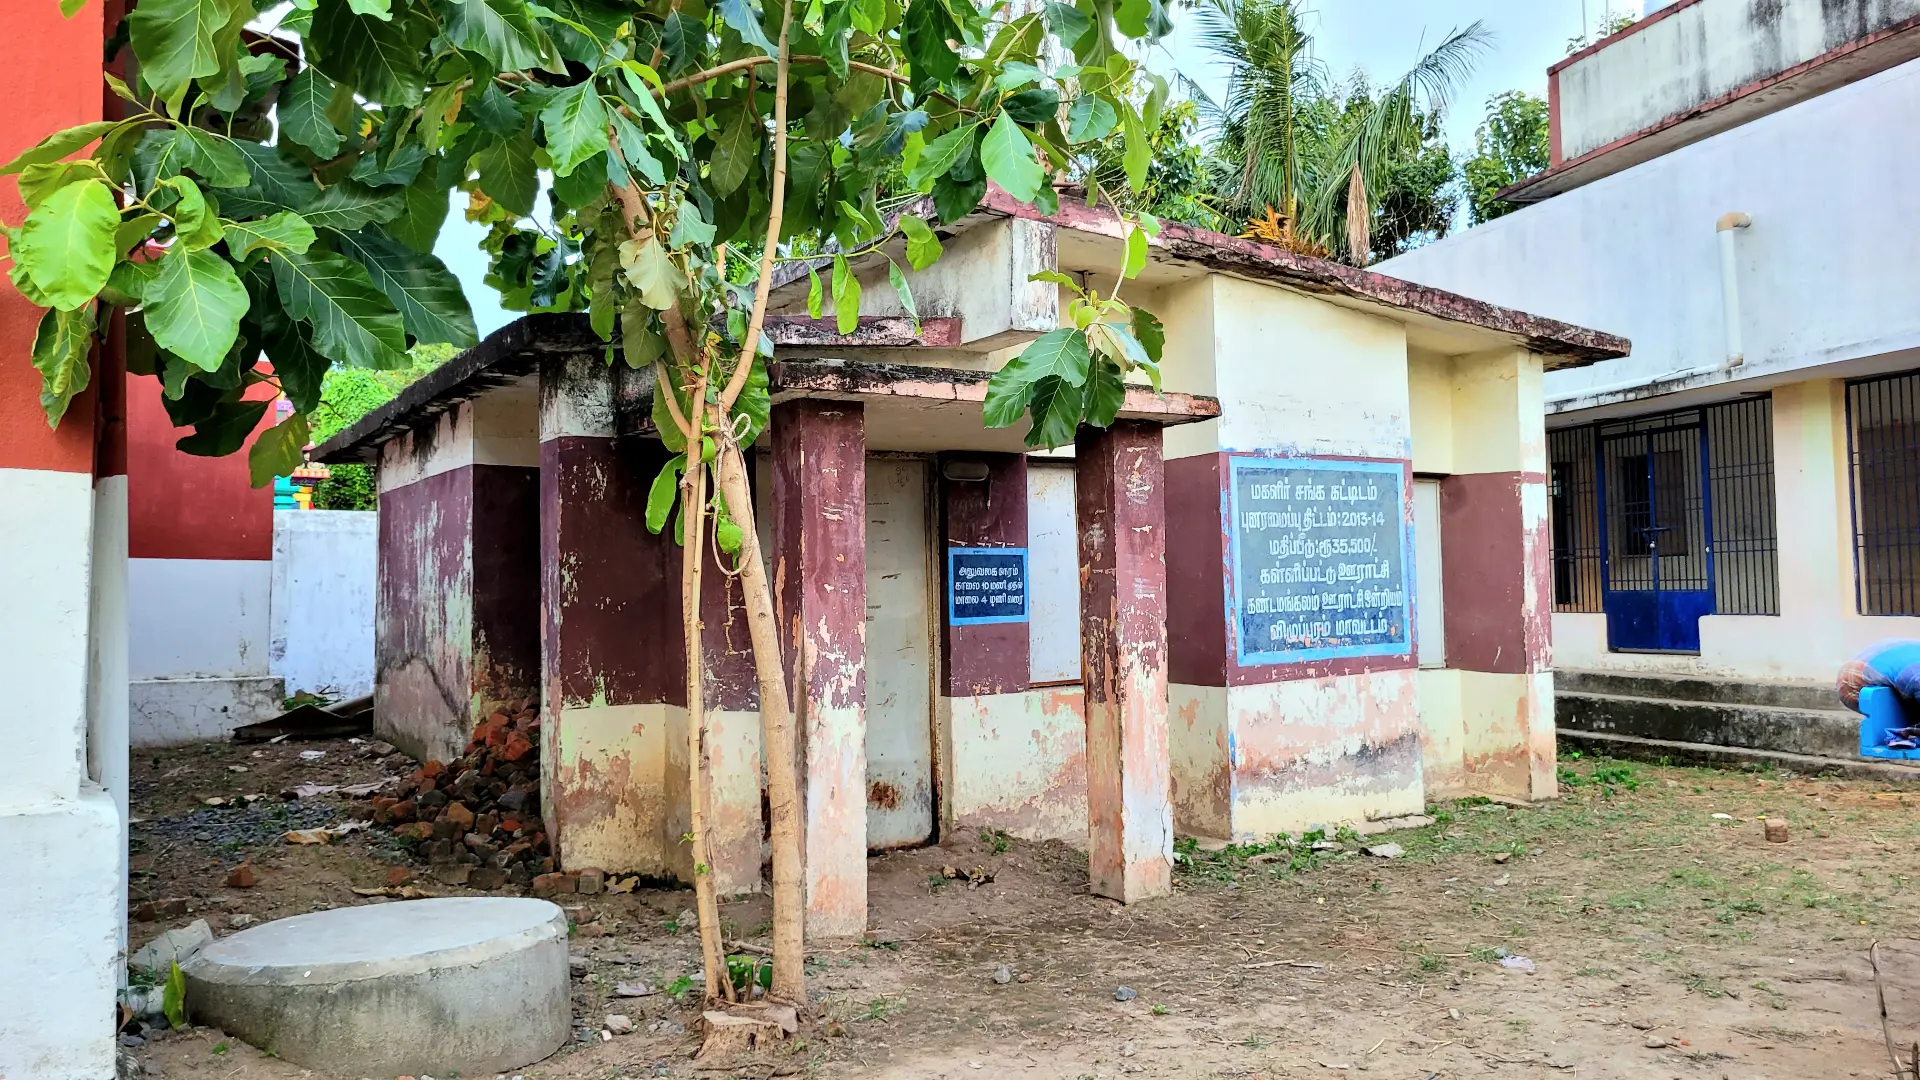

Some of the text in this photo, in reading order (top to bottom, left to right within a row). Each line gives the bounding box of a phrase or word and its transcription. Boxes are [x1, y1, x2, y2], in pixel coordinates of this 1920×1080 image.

[1295, 478, 1325, 500] சங்க
[1331, 478, 1377, 505] கட்டிடம்
[1337, 557, 1390, 584] ஊராட்சி
[955, 581, 980, 591] காலை
[990, 579, 1007, 591] மணி
[981, 596, 988, 604] 4
[1335, 611, 1388, 636] மாவட்டம்
